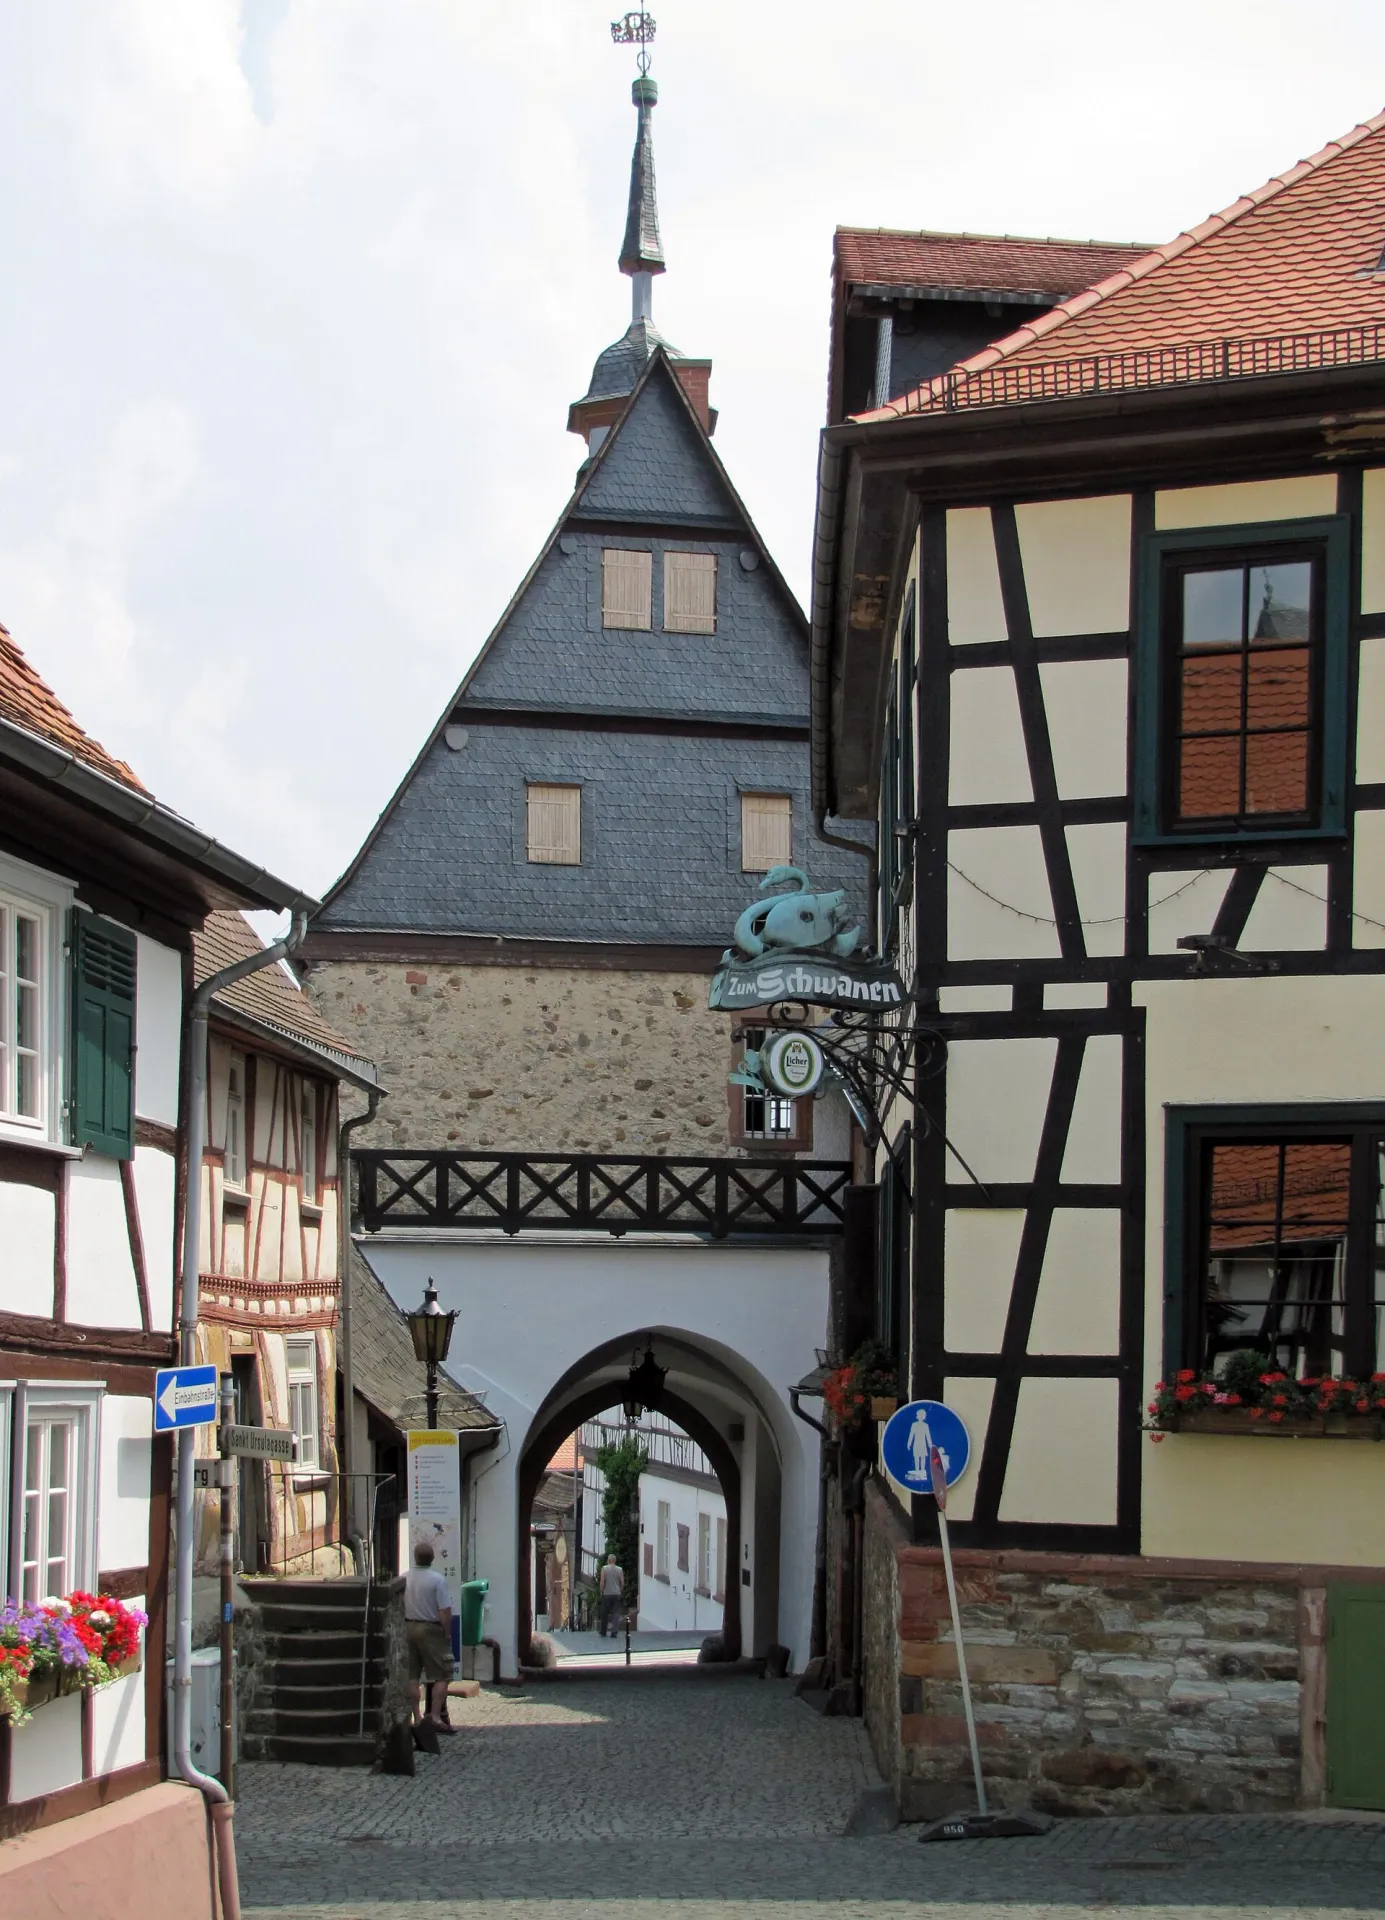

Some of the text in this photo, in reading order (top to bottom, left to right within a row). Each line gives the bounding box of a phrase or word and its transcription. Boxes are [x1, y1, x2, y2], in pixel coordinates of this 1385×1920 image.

[756, 967, 901, 1002] Schwanen
[786, 1055, 808, 1067] Licher
[175, 1388, 214, 1404] Einbahnstraße
[231, 1429, 289, 1457] Sankt Ursulagasse
